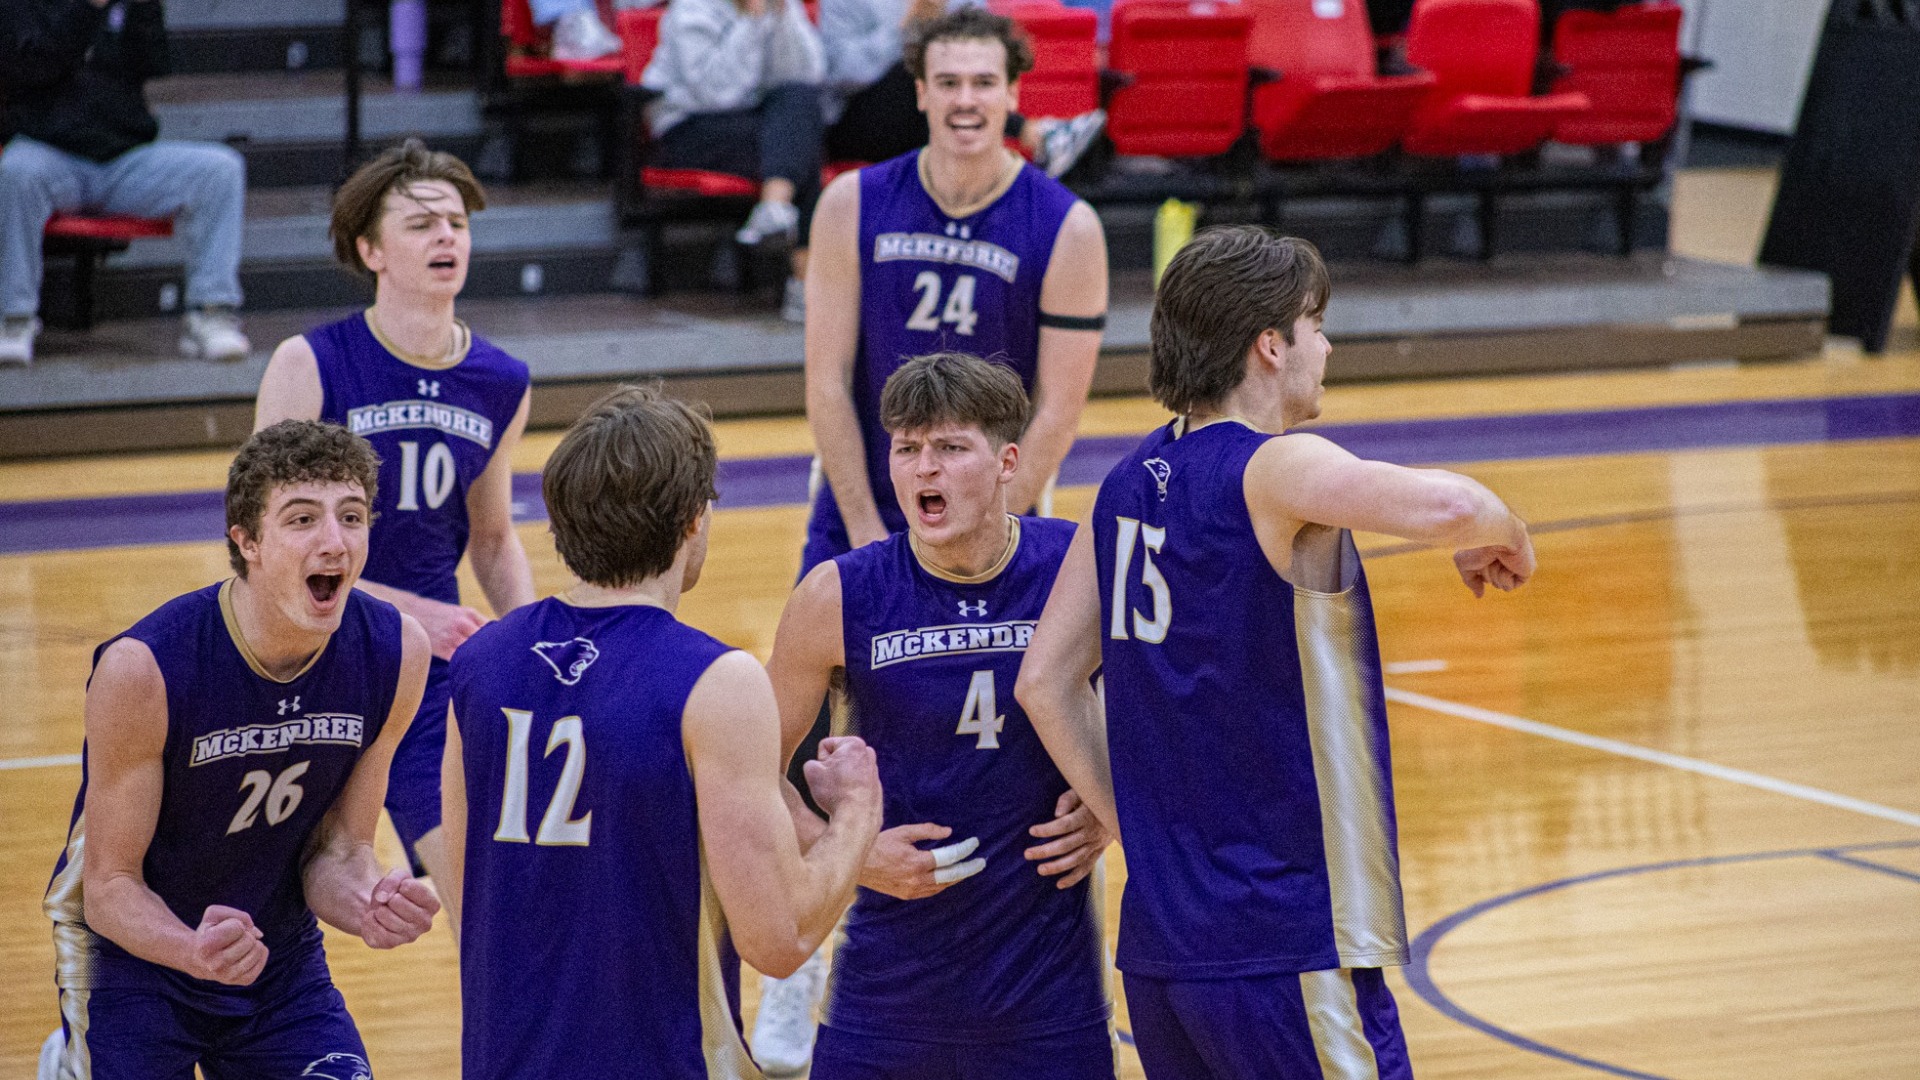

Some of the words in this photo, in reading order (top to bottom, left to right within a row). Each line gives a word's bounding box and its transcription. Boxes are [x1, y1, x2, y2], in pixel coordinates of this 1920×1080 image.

[905, 271, 978, 335] 24
[351, 403, 491, 443] McKENDREE
[396, 441, 456, 511] 10
[1110, 516, 1173, 644] 15
[875, 624, 1035, 664] McKENDR
[194, 715, 364, 763] McKENDREE
[955, 670, 1006, 749] 4
[225, 760, 311, 836] 26
[493, 707, 593, 846] 12
